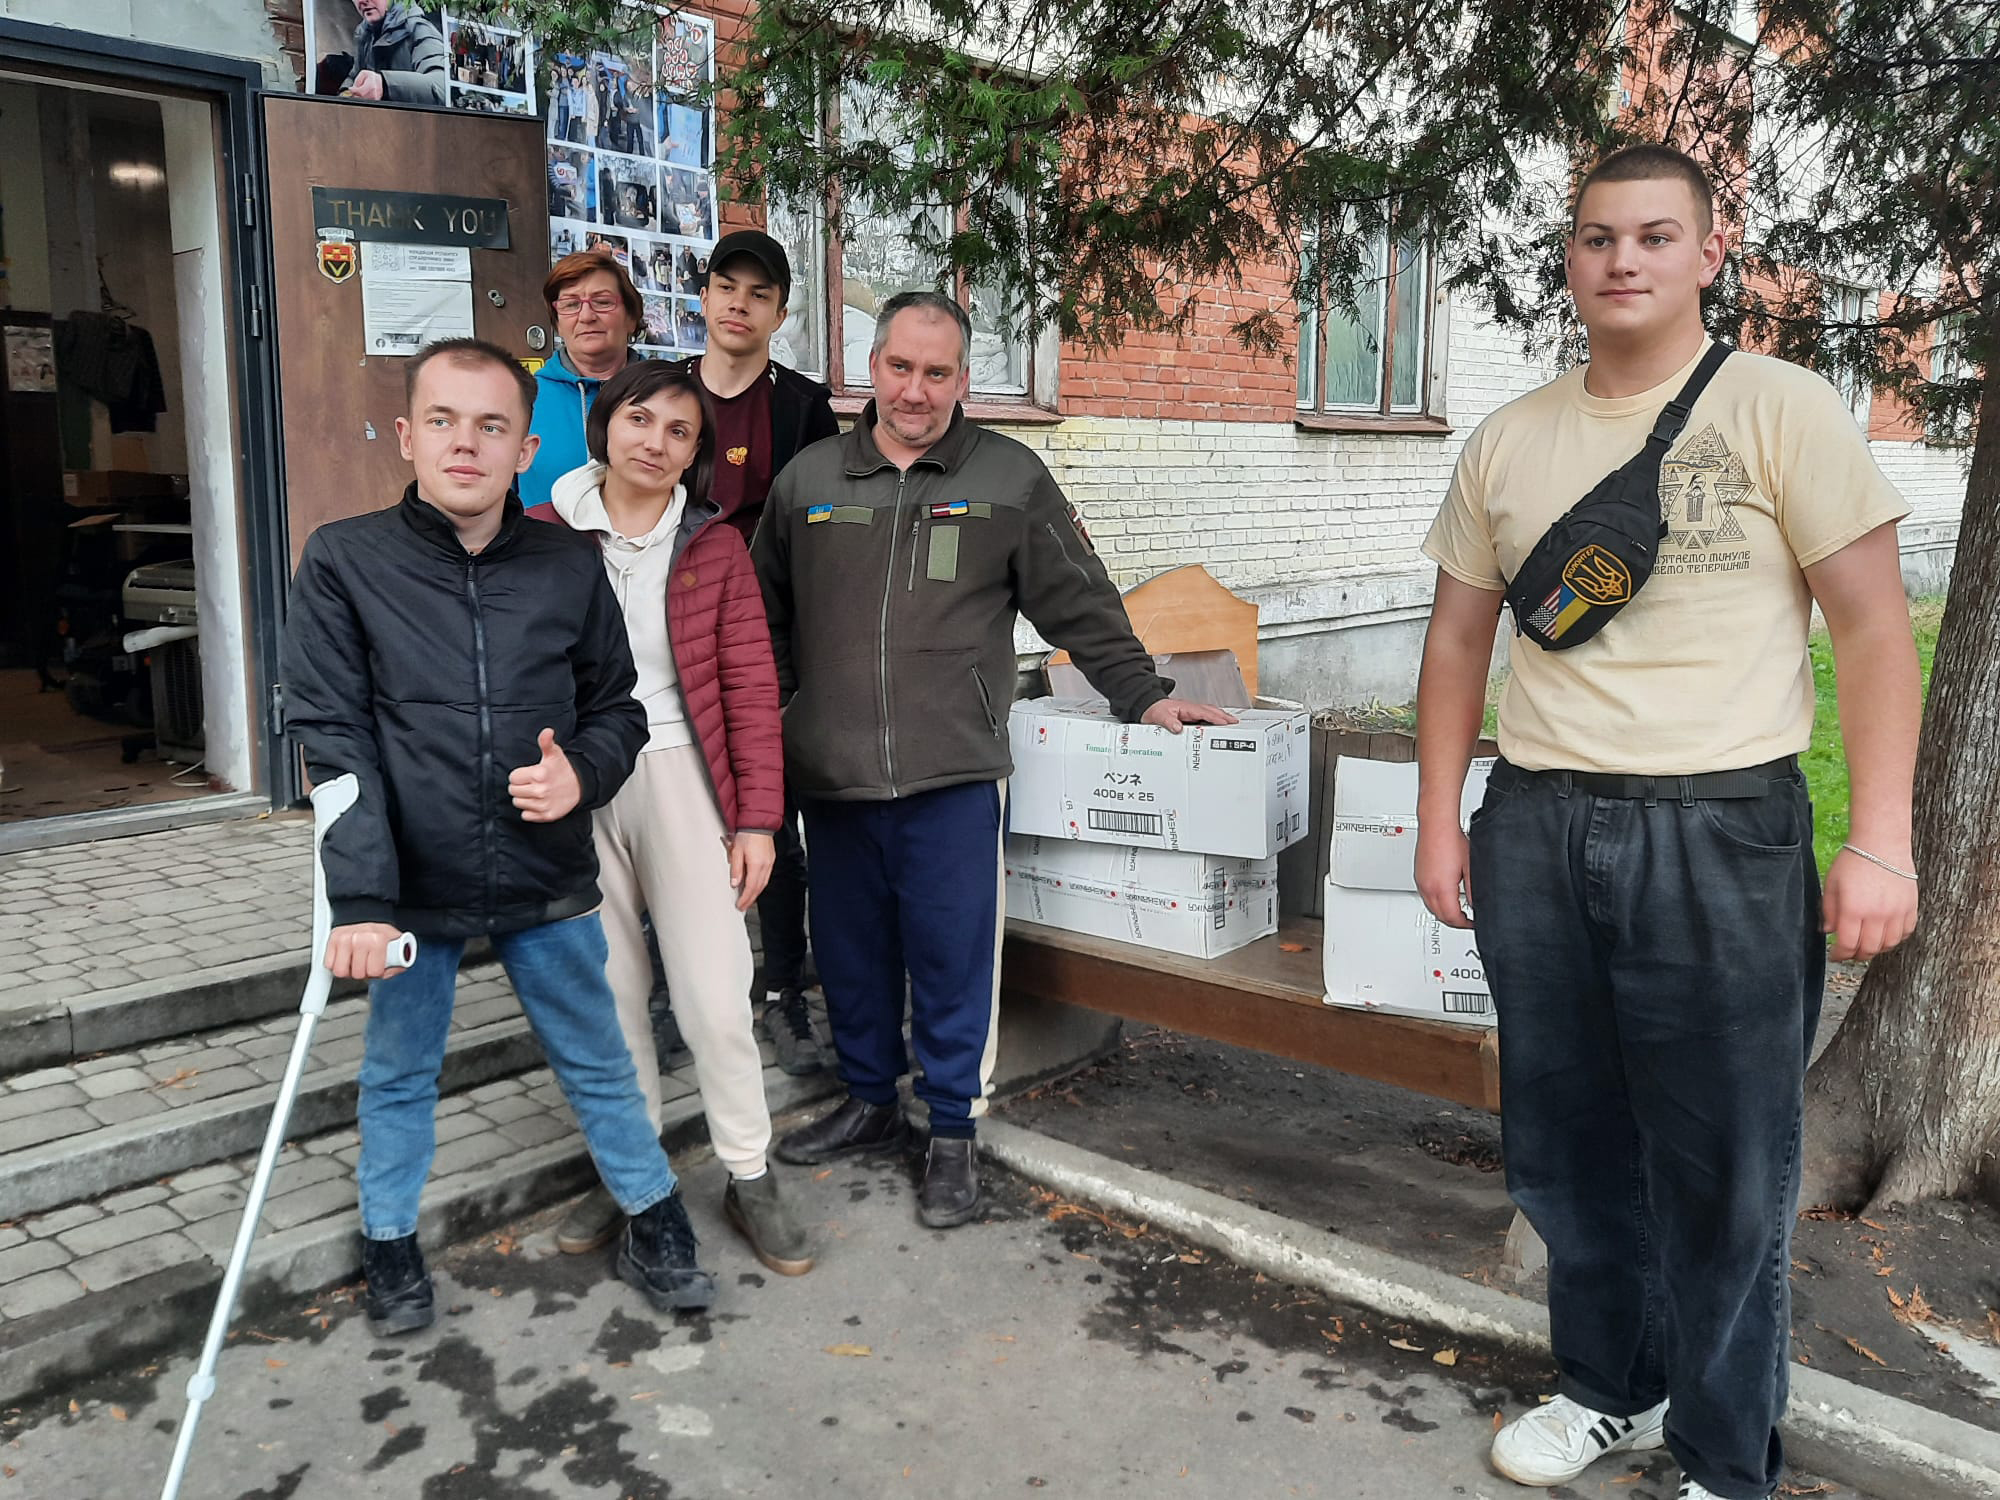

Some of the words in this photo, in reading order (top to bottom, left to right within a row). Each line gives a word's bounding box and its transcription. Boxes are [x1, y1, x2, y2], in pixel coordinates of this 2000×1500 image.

[443, 206, 498, 237] YOU
[1709, 550, 1751, 562] МИНУЛЕ
[1651, 565, 1684, 576] ВЕМО
[1686, 560, 1750, 574] ТЕПЕРІШНІМ
[1138, 791, 1155, 802] 25
